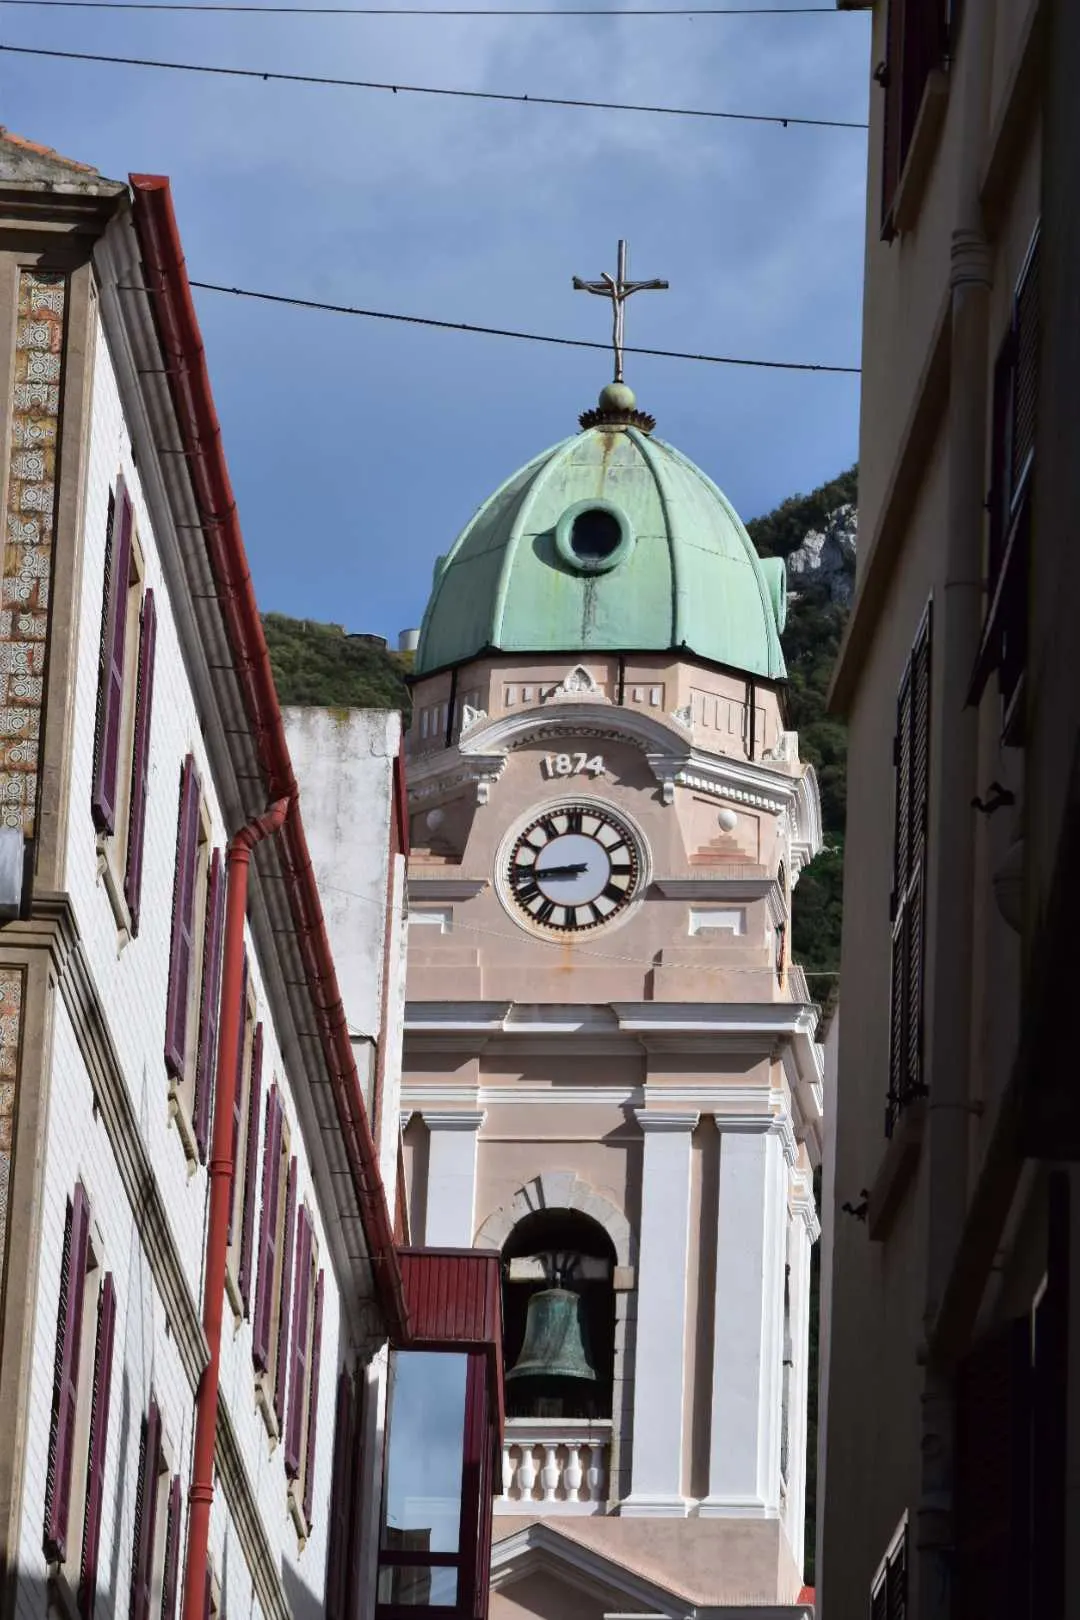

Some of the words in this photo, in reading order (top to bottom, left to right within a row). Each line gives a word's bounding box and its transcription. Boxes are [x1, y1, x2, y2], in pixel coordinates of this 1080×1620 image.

[544, 752, 606, 776] 1874
[541, 817, 559, 840] XI
[566, 813, 582, 834] XII
[592, 819, 606, 838] I
[519, 837, 542, 855] X
[606, 839, 626, 853] II
[611, 864, 632, 875] III
[564, 906, 577, 927] VI
[589, 901, 604, 919] V
